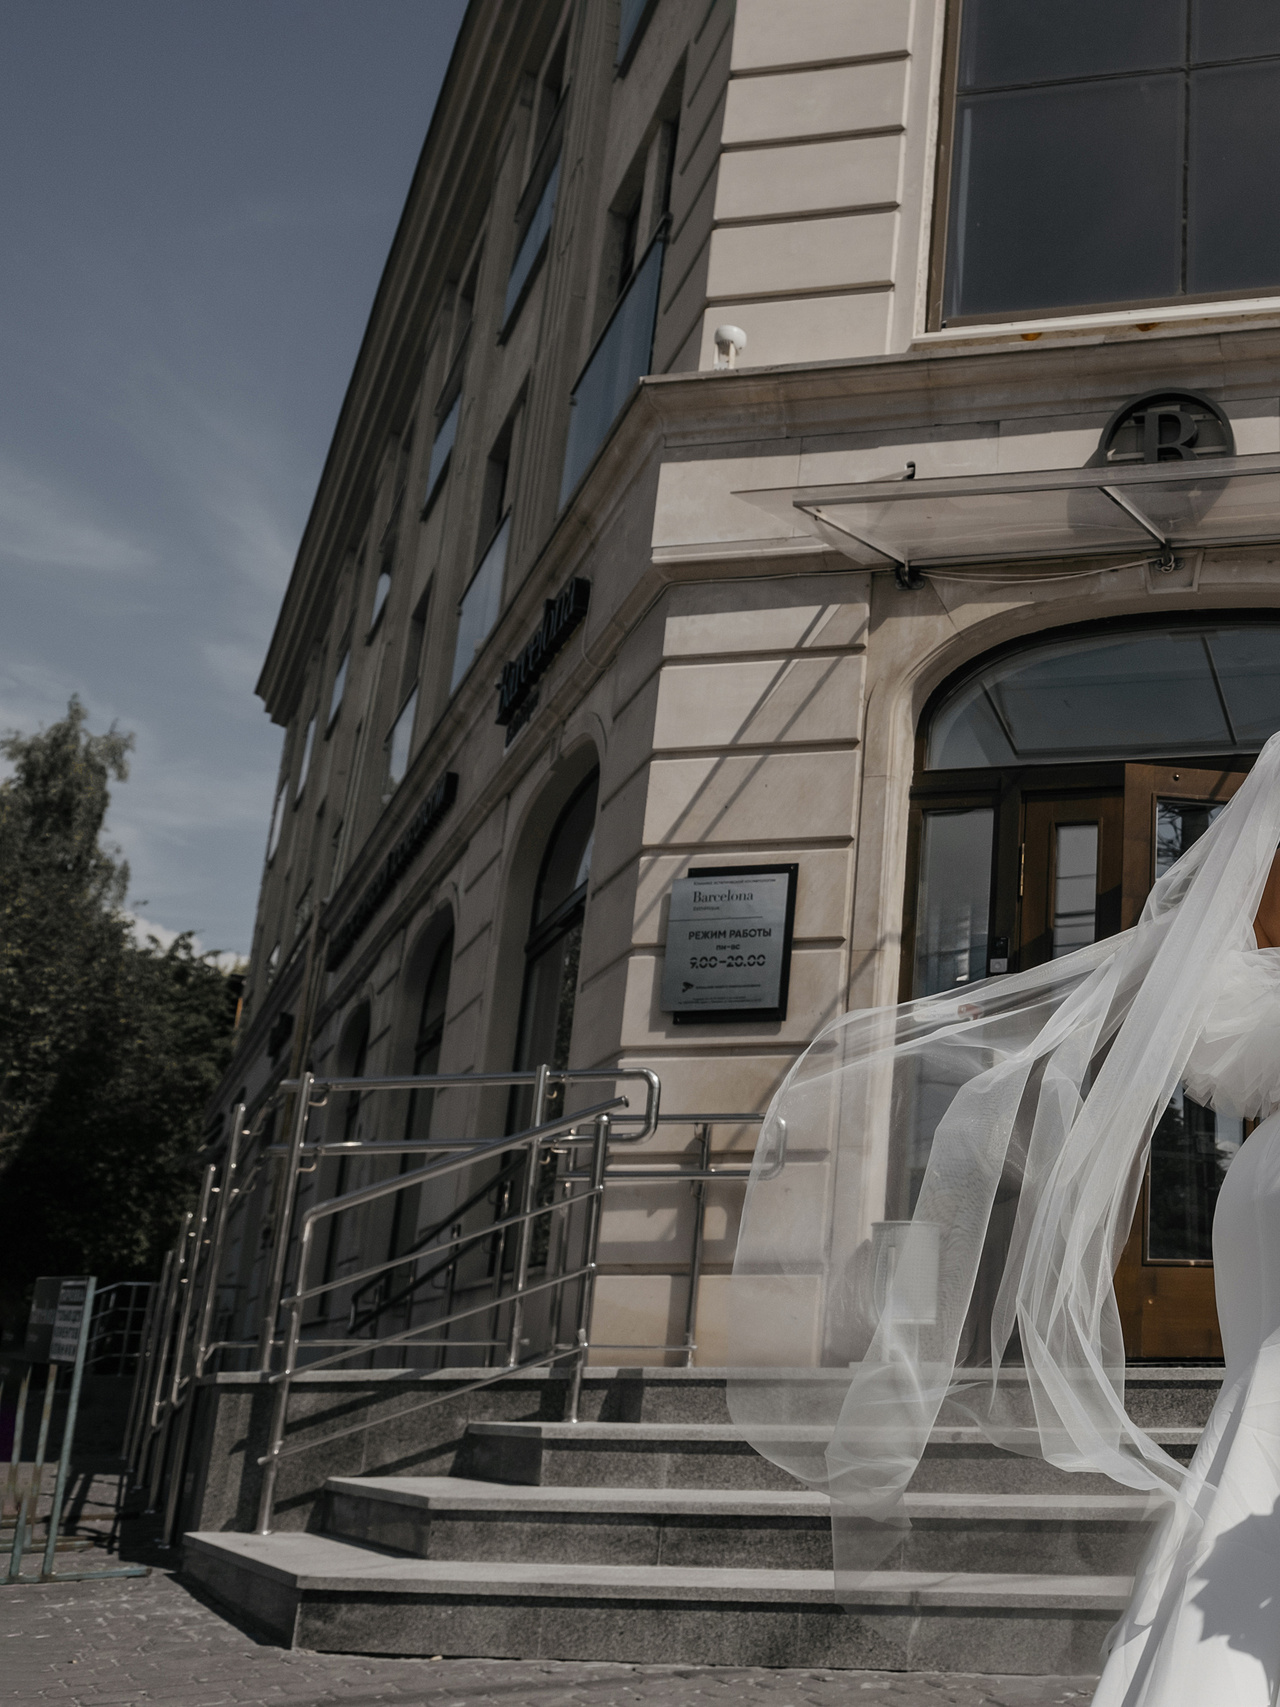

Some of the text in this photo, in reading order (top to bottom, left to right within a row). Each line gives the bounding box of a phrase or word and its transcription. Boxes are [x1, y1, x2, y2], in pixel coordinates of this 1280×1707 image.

[693, 889, 754, 904] Barcelona
[688, 928, 772, 940] РЕЖИМ РАБОТЫ
[689, 954, 767, 969] 9.00-20.00
